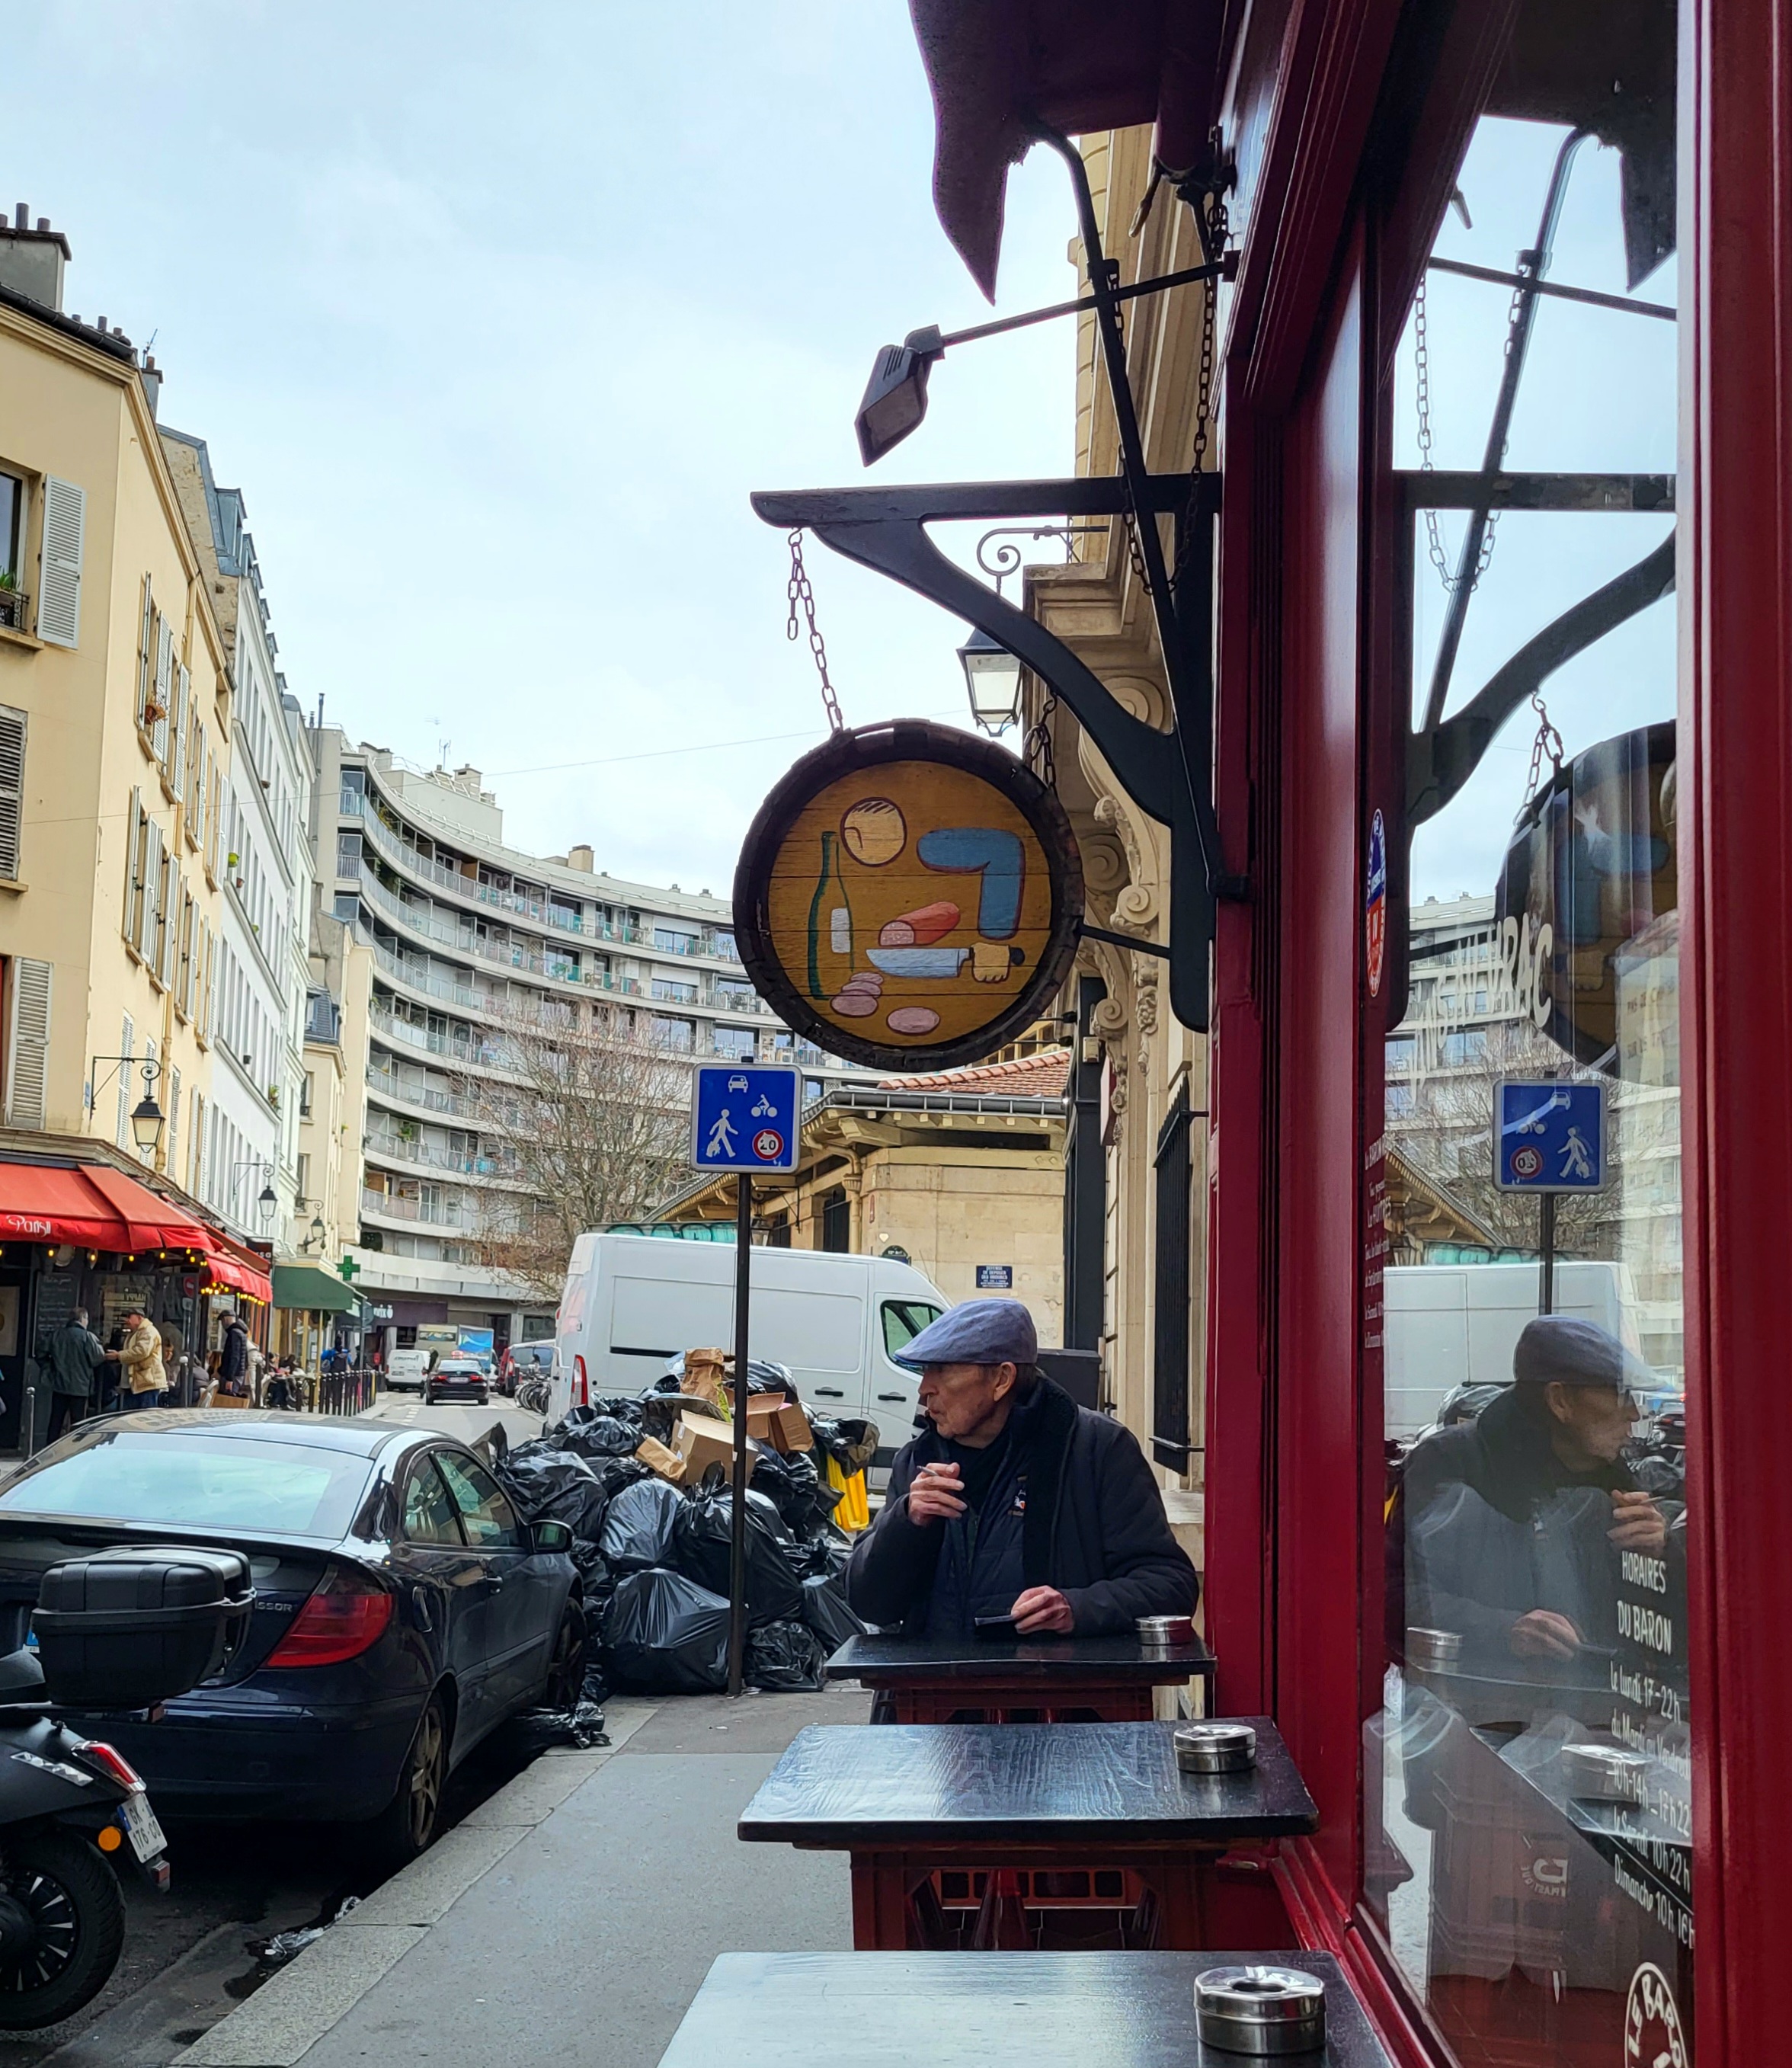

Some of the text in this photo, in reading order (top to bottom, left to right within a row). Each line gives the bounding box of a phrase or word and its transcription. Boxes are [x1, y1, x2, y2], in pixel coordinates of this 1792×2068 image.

[1486, 912, 1553, 1028] VRAC
[760, 1139, 776, 1151] 20
[1621, 1550, 1666, 1594] HORAIRES
[1617, 1599, 1672, 1656] DU BARON
[1620, 1664, 1643, 1705] lundi
[1614, 1853, 1654, 1913] Dimanche
